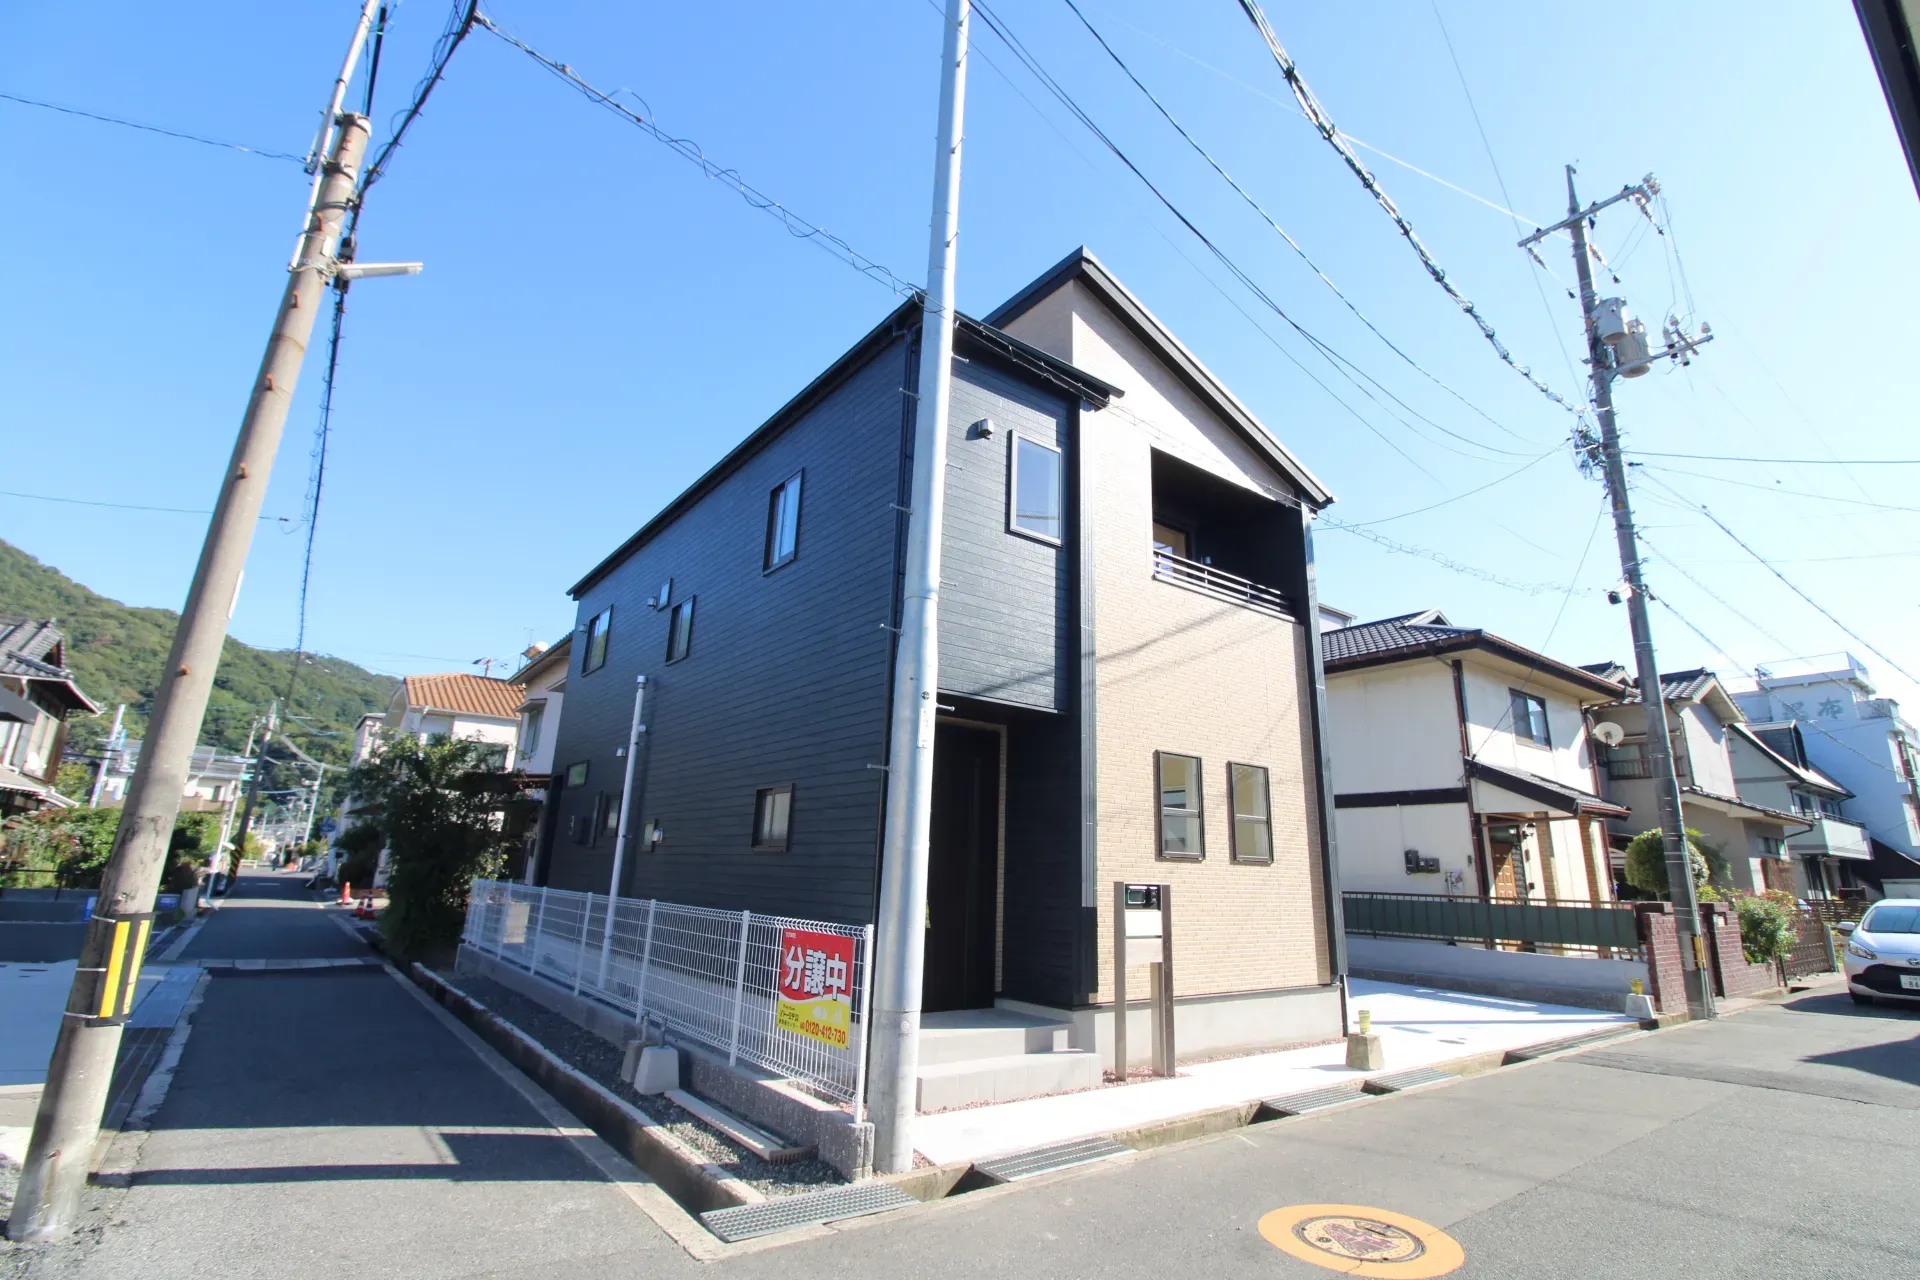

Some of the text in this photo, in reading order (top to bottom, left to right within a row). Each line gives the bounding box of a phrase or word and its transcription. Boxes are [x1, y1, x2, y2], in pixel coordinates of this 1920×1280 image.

[785, 945, 847, 1000] 分譲中
[805, 1020, 846, 1044] 0120-412-730
